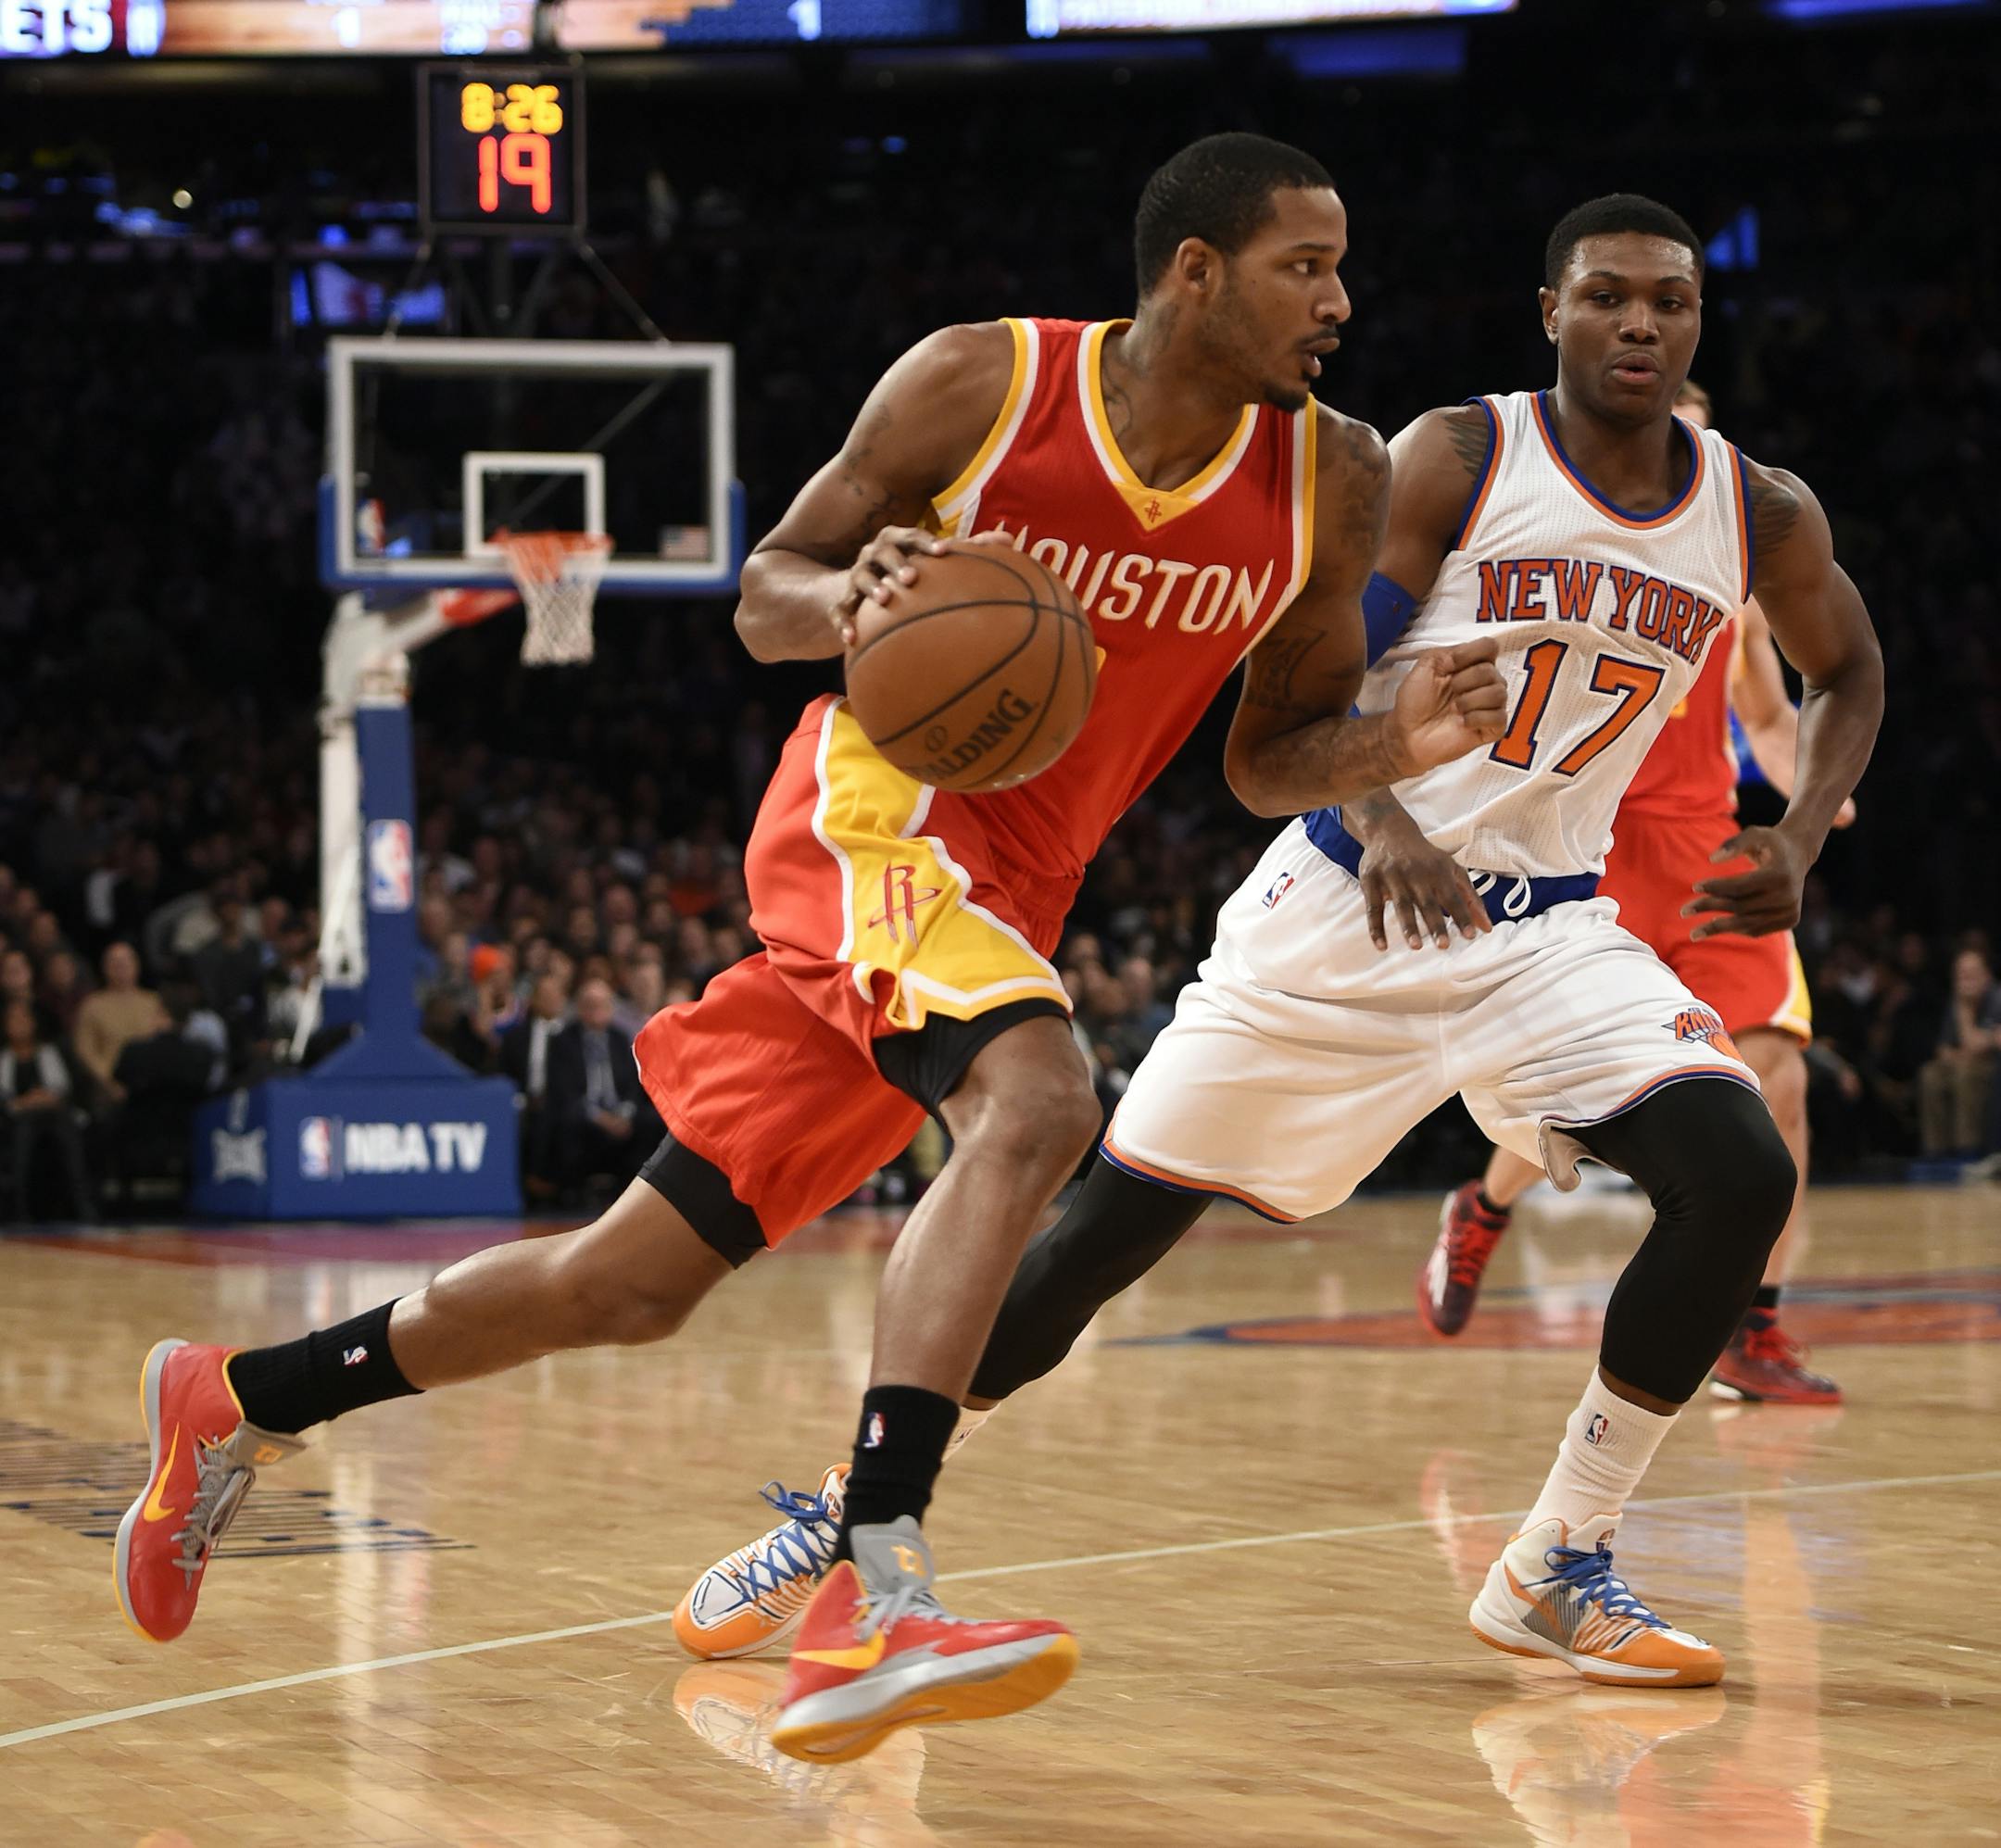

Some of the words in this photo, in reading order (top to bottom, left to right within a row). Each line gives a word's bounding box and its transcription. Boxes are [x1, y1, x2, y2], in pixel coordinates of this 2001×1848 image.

[461, 82, 563, 134] 8:26
[478, 132, 552, 214] 19
[1476, 559, 1604, 623] NEW
[1608, 565, 1724, 666] YORK
[1488, 637, 1666, 776] 17
[344, 1123, 430, 1174] NBA
[429, 1121, 487, 1174] TV
